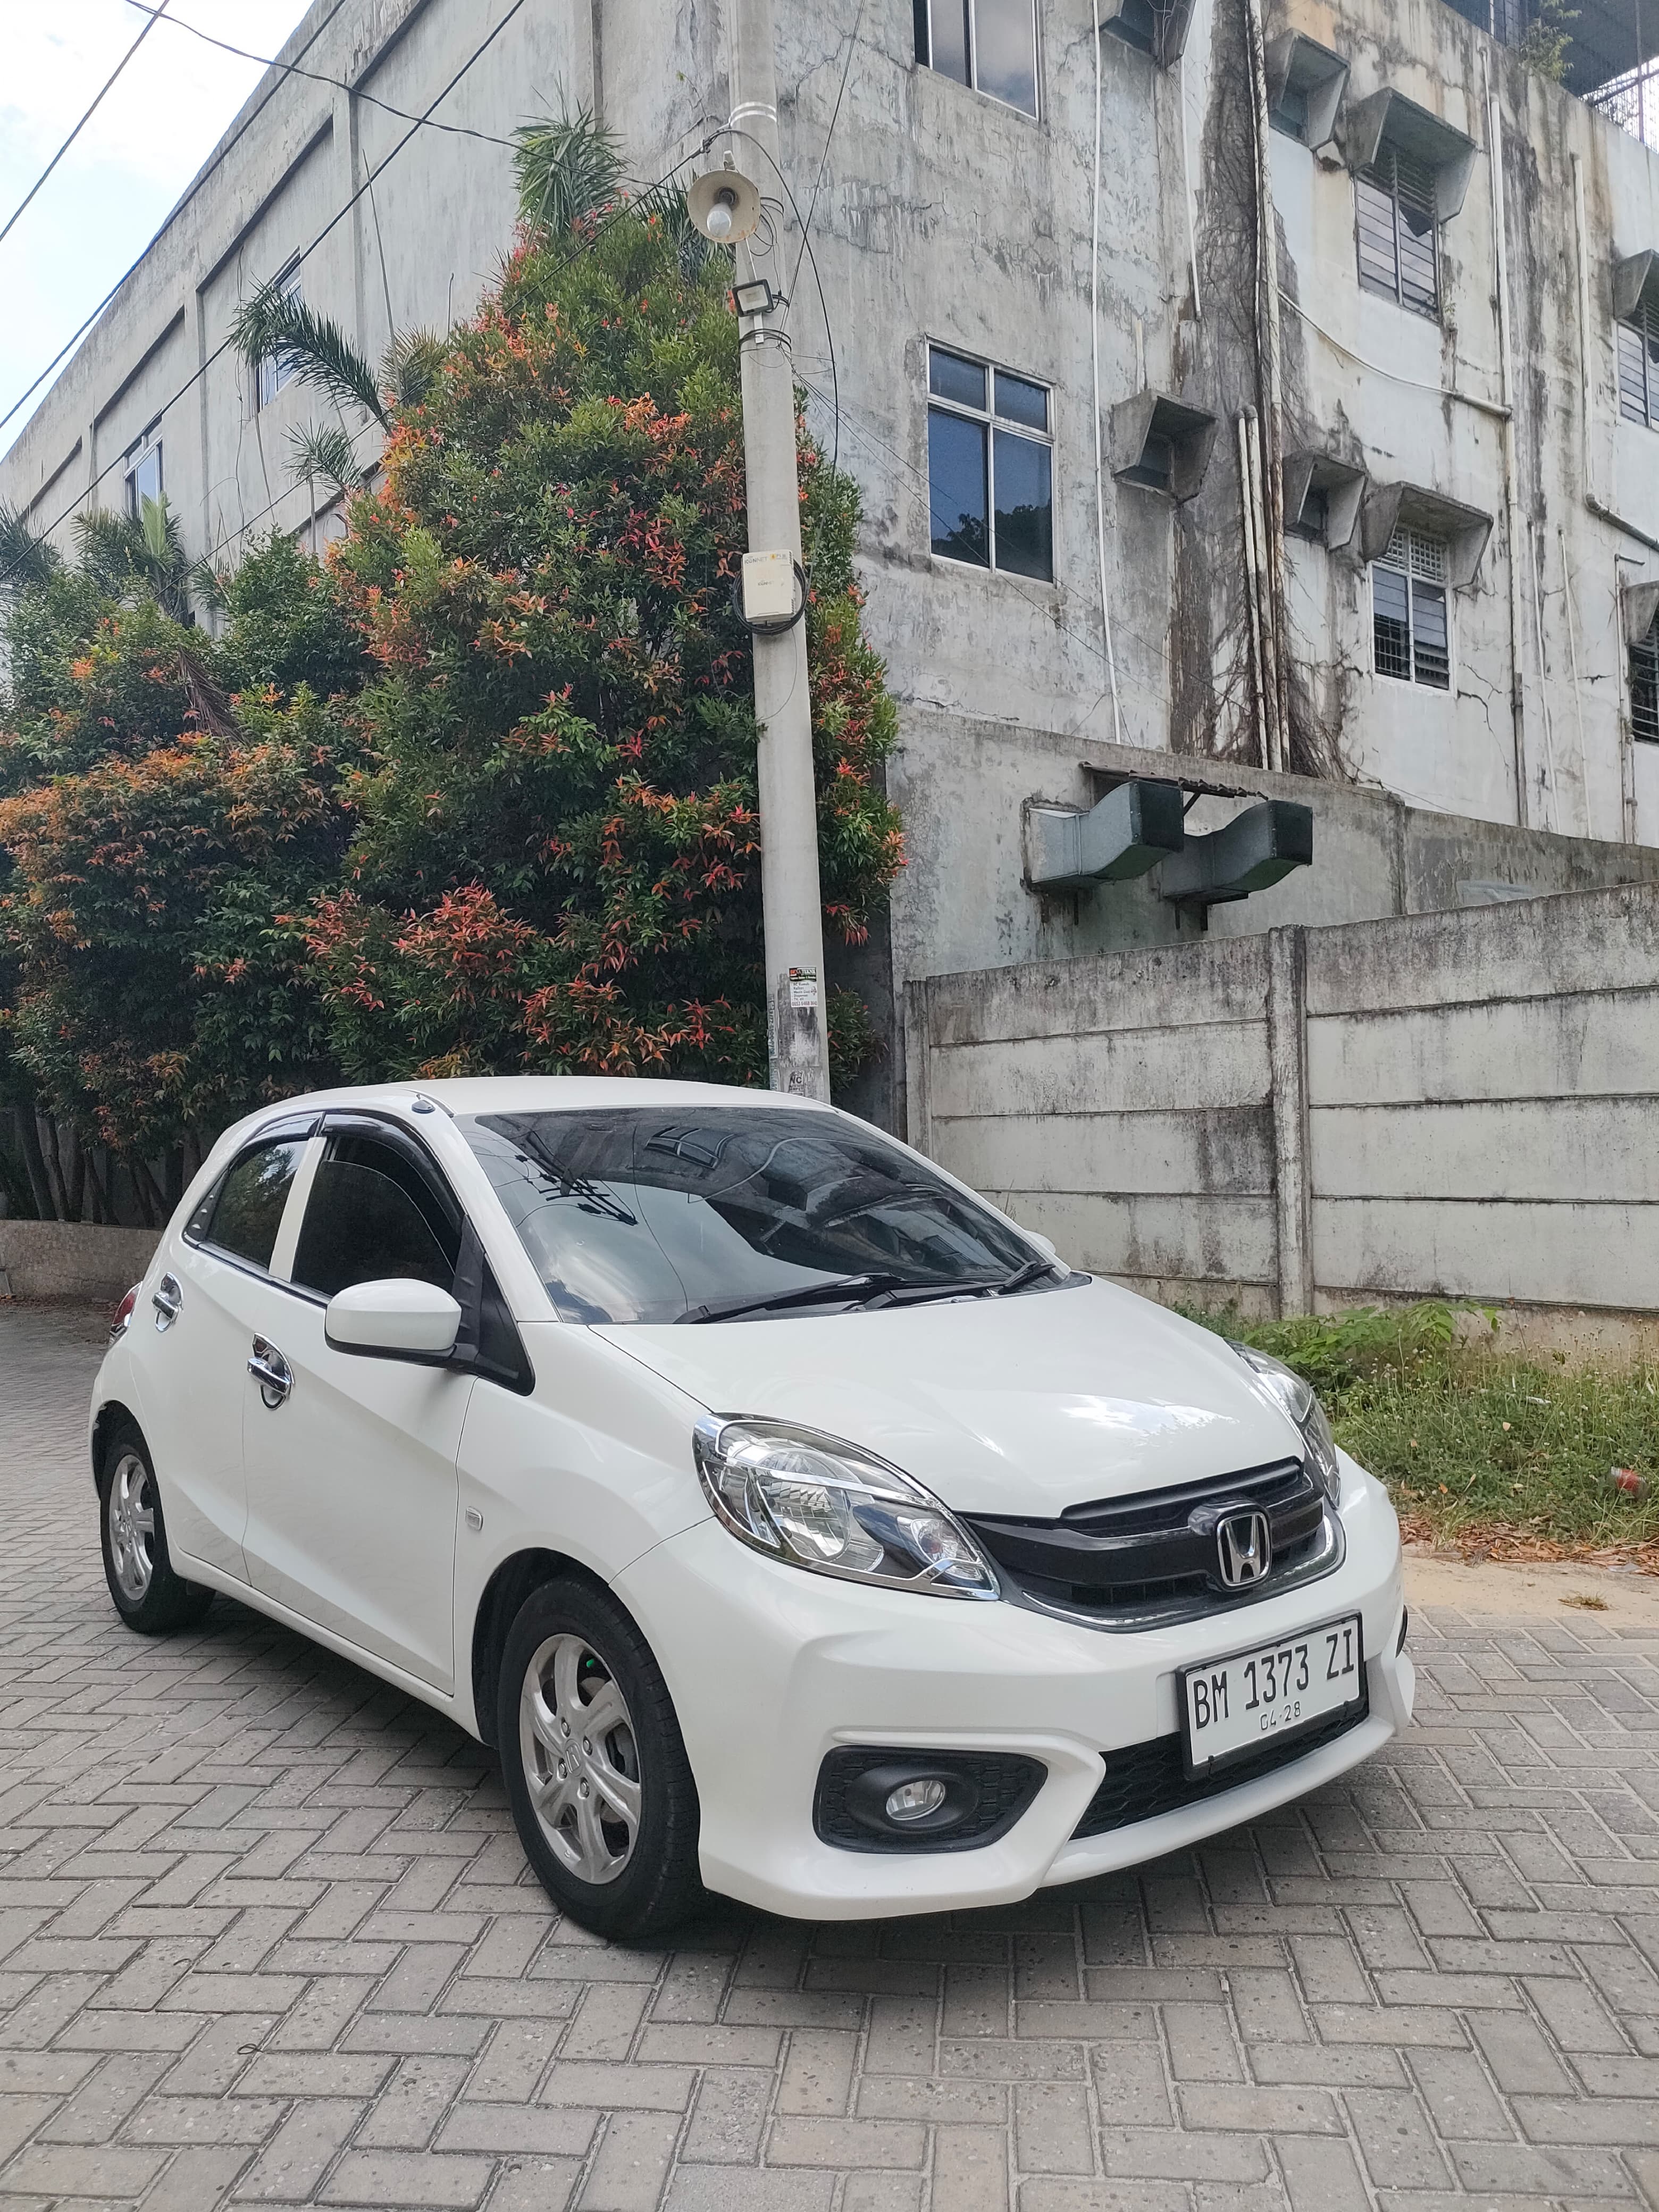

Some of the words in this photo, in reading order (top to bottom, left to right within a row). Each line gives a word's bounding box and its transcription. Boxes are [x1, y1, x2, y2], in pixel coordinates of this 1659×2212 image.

[1193, 1671, 1229, 1730] BM
[1243, 1644, 1309, 1711] 1373
[1326, 1628, 1354, 1681] ZI
